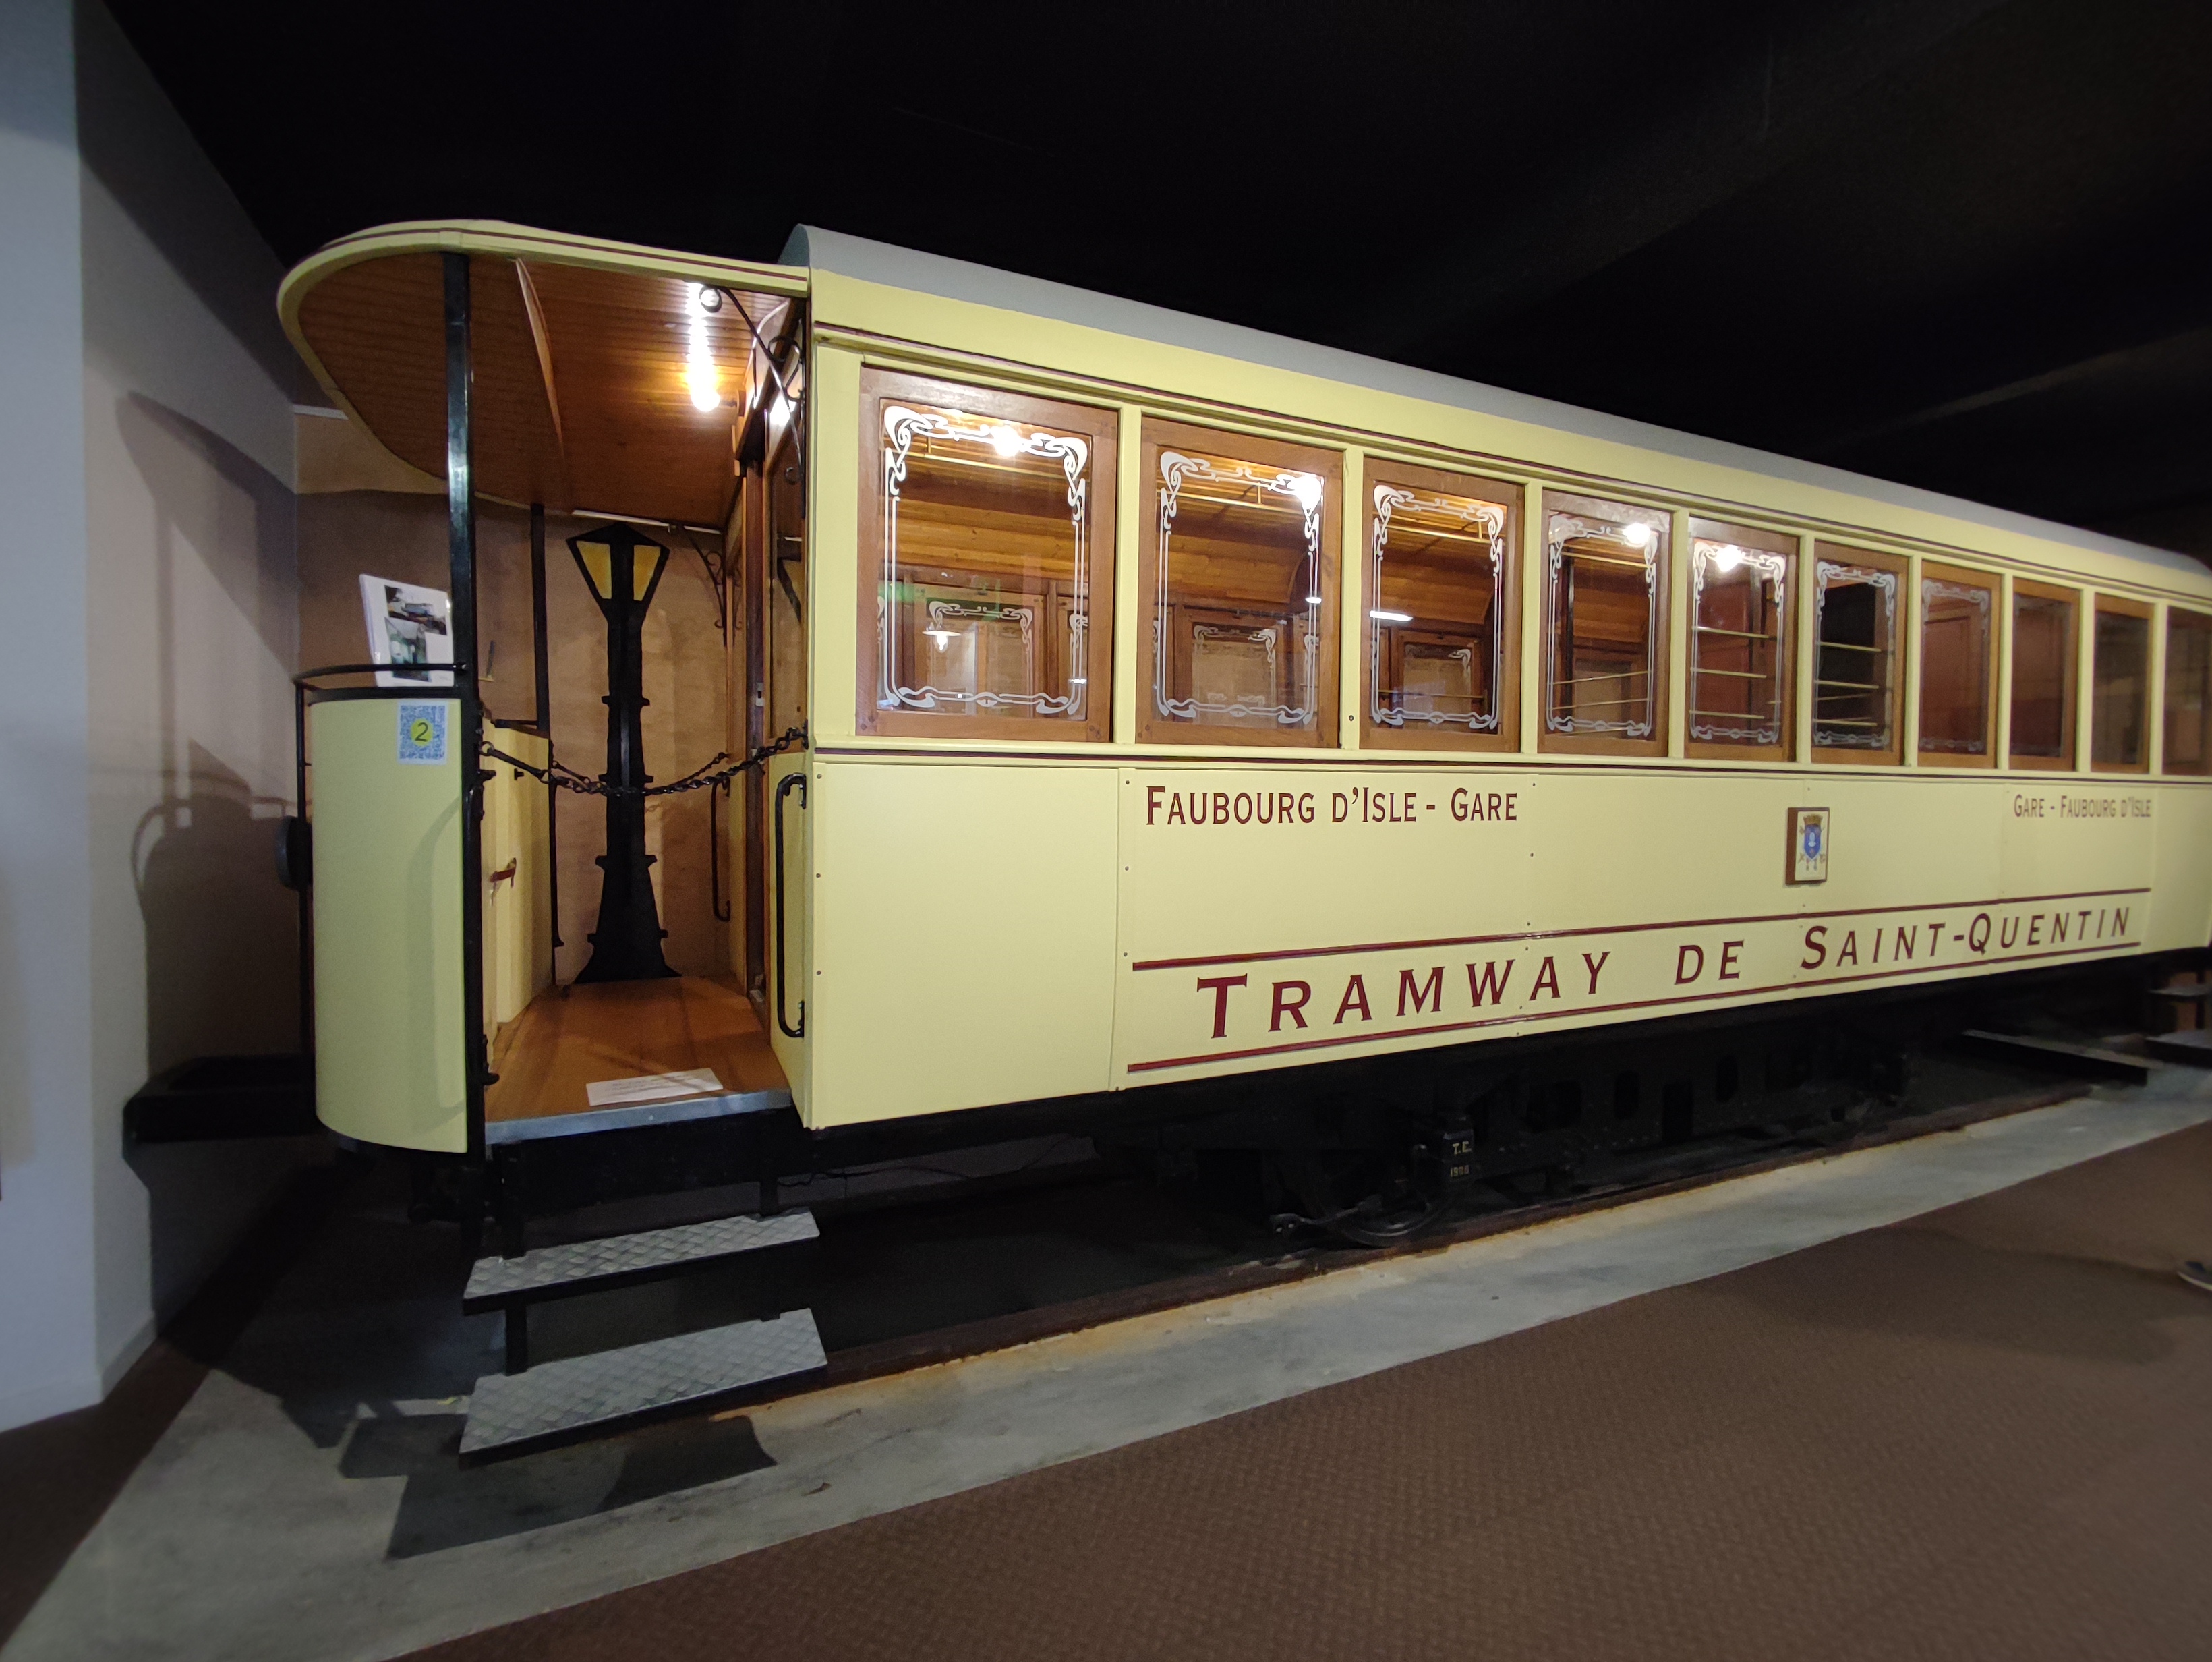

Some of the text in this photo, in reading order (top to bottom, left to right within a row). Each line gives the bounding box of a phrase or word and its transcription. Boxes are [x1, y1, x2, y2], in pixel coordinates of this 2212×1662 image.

[415, 721, 429, 743] 2
[1146, 785, 1315, 825] FAUBOURG
[1331, 786, 1417, 823] D'ISLE
[1451, 787, 1518, 822] GARE
[2014, 793, 2045, 818] GARE
[2060, 795, 2116, 818] FAUBOURG
[1196, 907, 2130, 1039] TRAMWAY DE SAINT-QUENTIN
